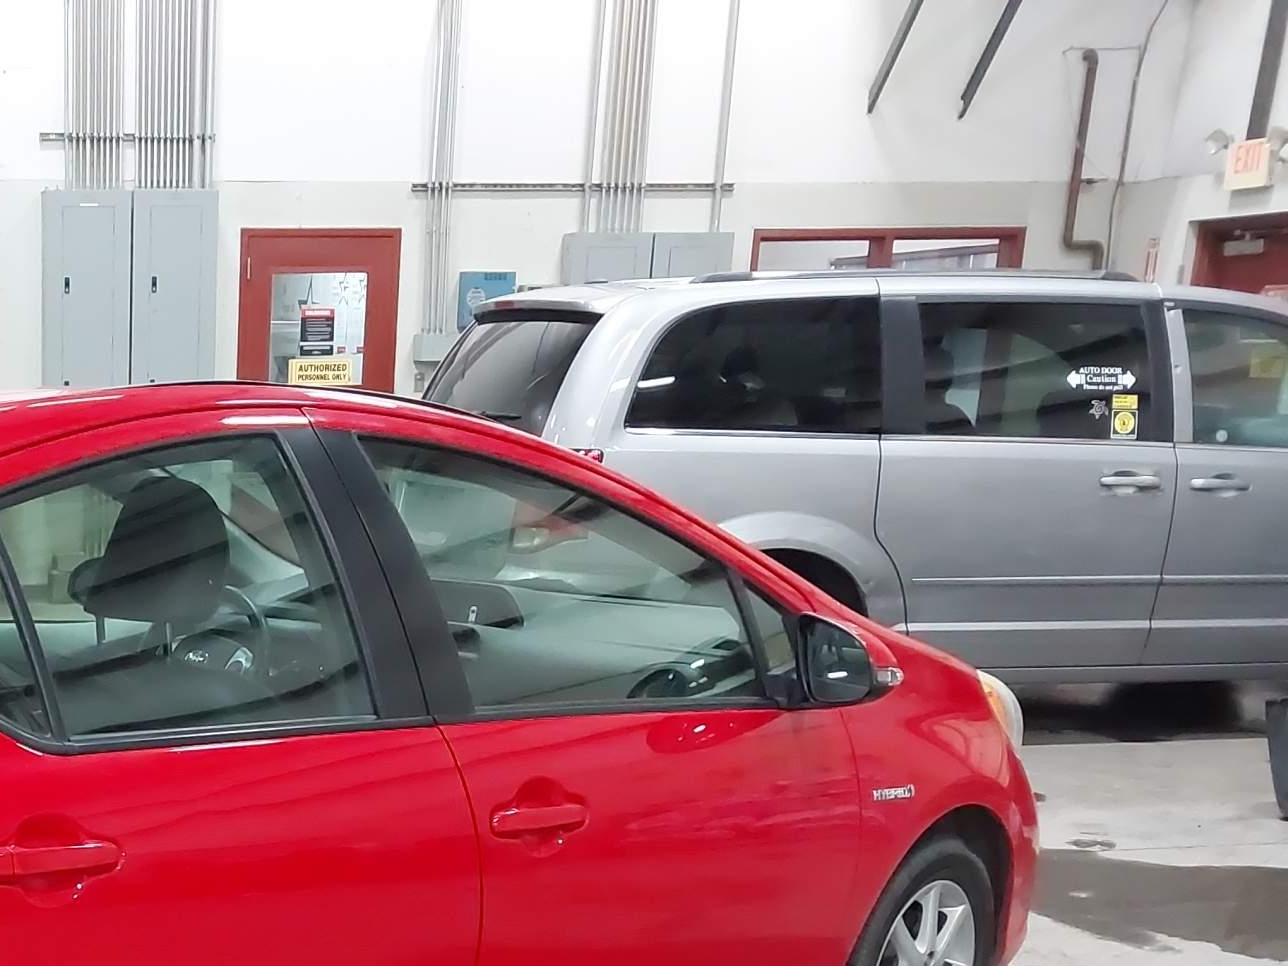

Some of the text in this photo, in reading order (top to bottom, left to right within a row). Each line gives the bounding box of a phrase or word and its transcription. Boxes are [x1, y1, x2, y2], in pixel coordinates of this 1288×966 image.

[1234, 143, 1266, 174] EXIT
[298, 363, 347, 372] AUTHORIZED
[332, 373, 347, 381] ONLY
[1087, 374, 1117, 383] Caution
[872, 783, 915, 801] HYBRID
